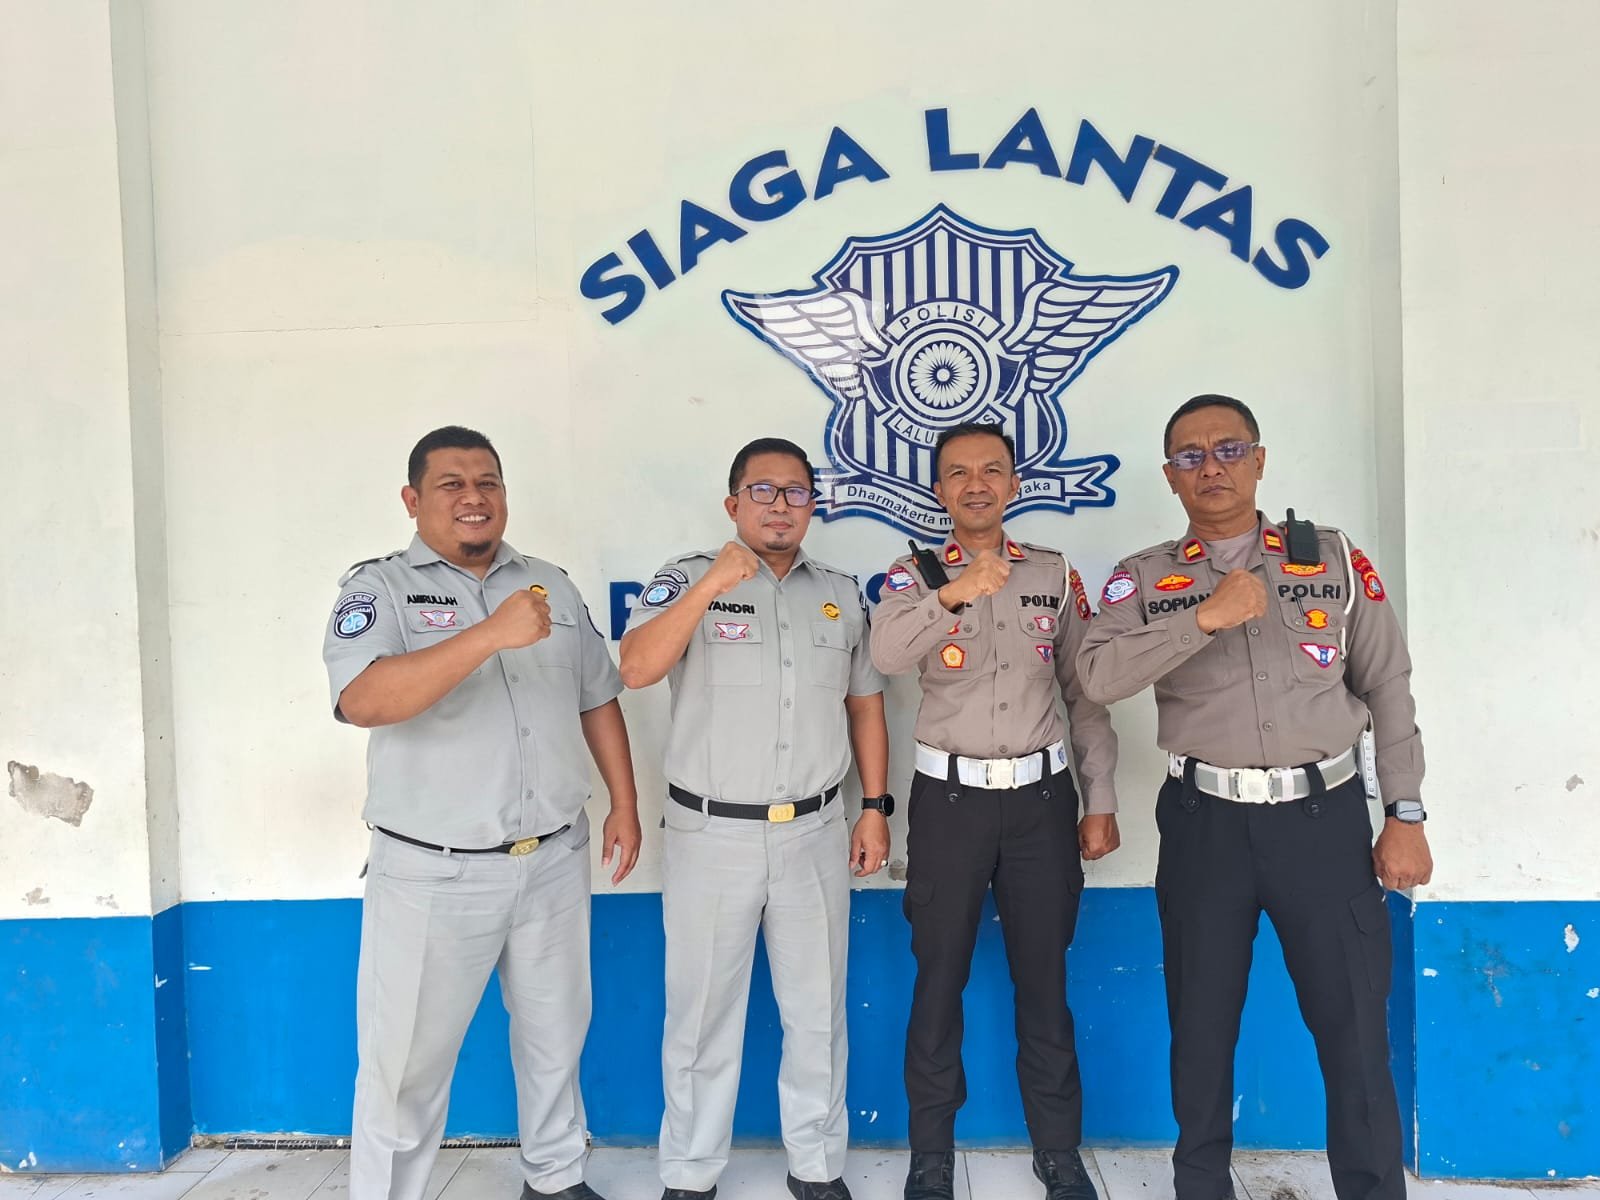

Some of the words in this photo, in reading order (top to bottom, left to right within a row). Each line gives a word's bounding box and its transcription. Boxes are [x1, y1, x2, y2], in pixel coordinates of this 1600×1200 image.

[579, 126, 891, 326] SIAGA
[924, 107, 1331, 290] LANTAS
[899, 304, 987, 331] POLISI
[893, 417, 935, 444] LALU
[847, 485, 936, 525] Dharmakerta
[1016, 480, 1051, 499] yaka
[1277, 583, 1341, 600] POLRI
